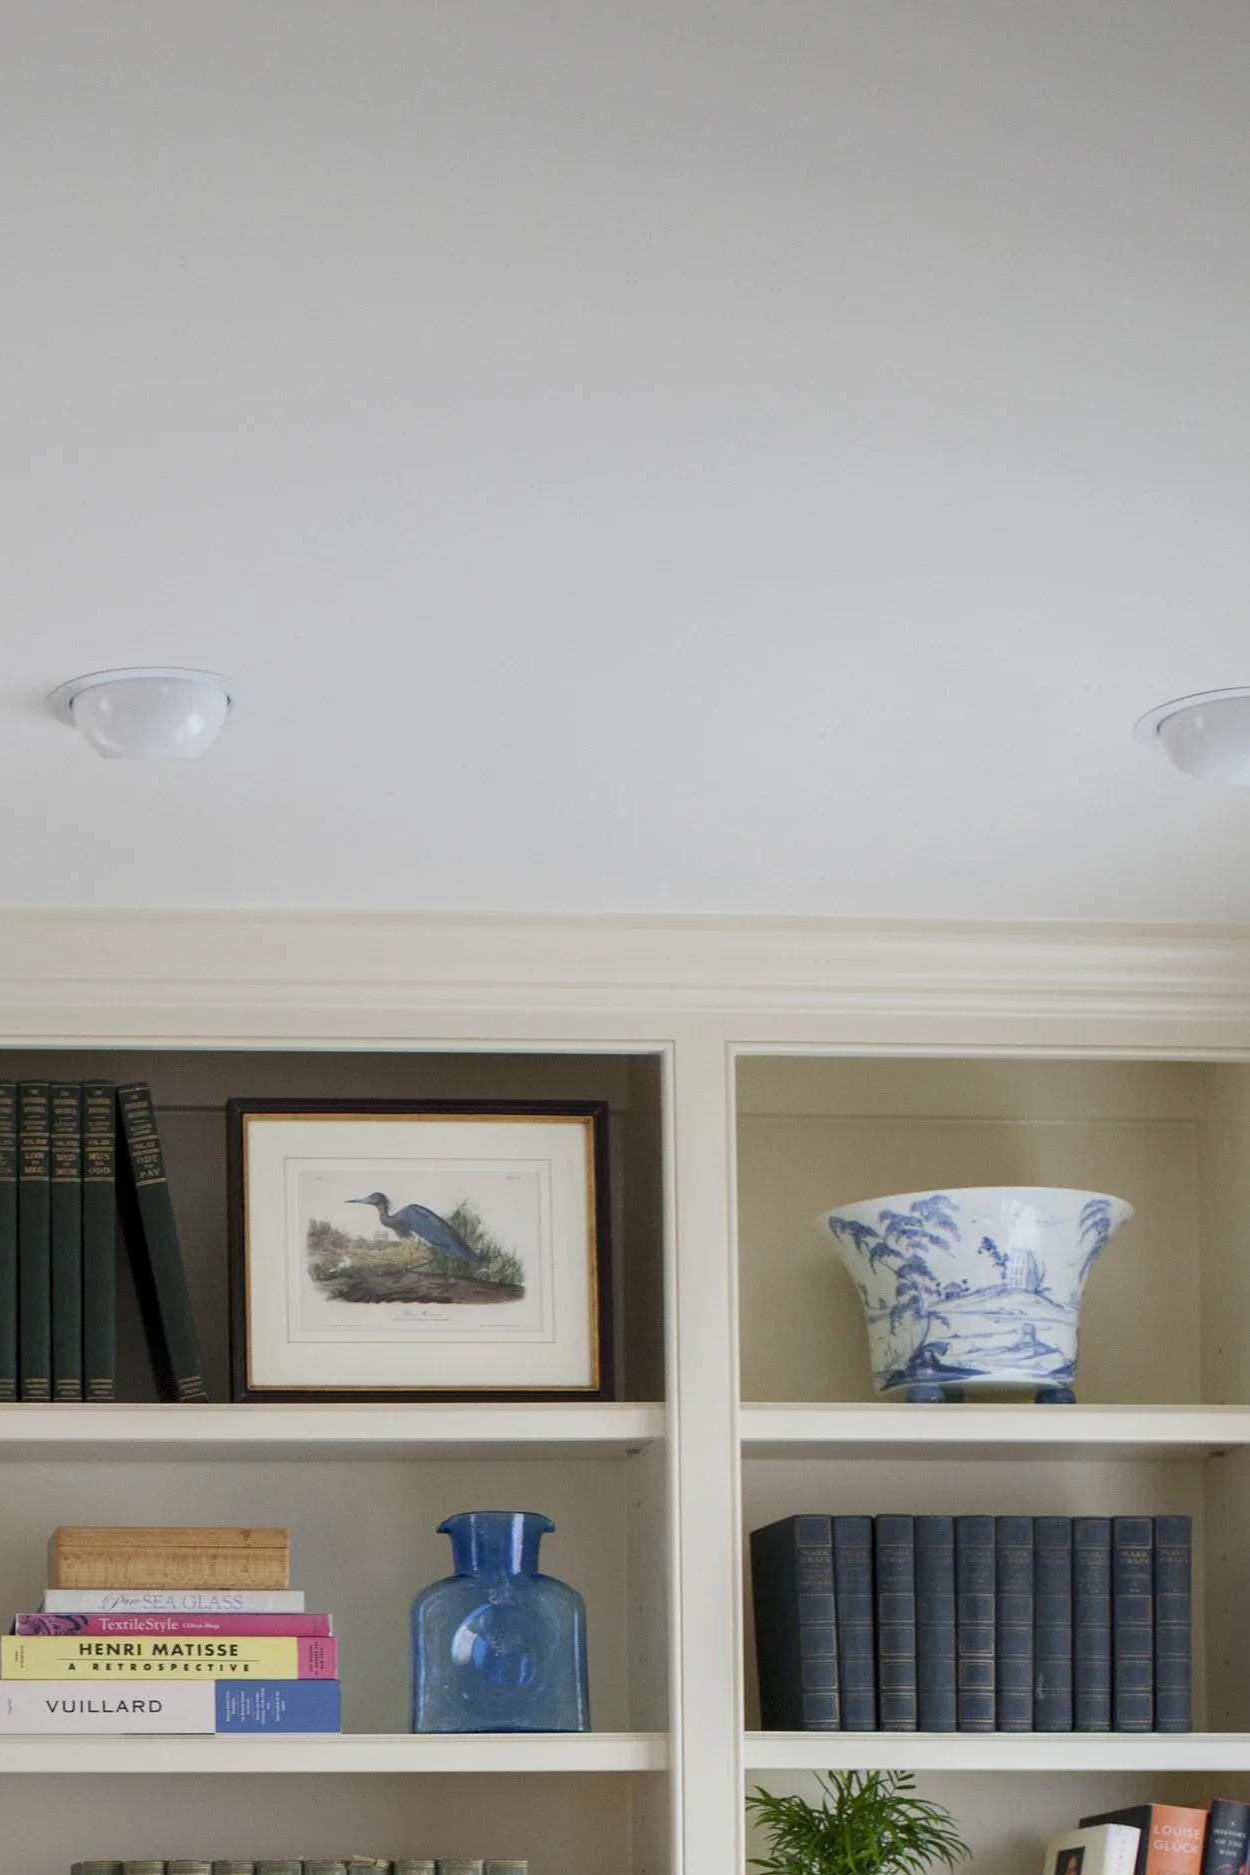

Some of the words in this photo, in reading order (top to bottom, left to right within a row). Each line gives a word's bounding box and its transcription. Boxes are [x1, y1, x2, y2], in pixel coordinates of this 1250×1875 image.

[143, 1595, 176, 1609] SEA
[183, 1595, 243, 1610] GLASS
[99, 1618, 178, 1632] TextileStyle
[79, 1643, 141, 1656] HENRI
[152, 1644, 238, 1656] MATISSE
[68, 1663, 76, 1671] A
[93, 1663, 250, 1672] RETROSPECTIVE
[46, 1700, 162, 1714] VUILLARD
[1153, 1824, 1202, 1840] LOUISE
